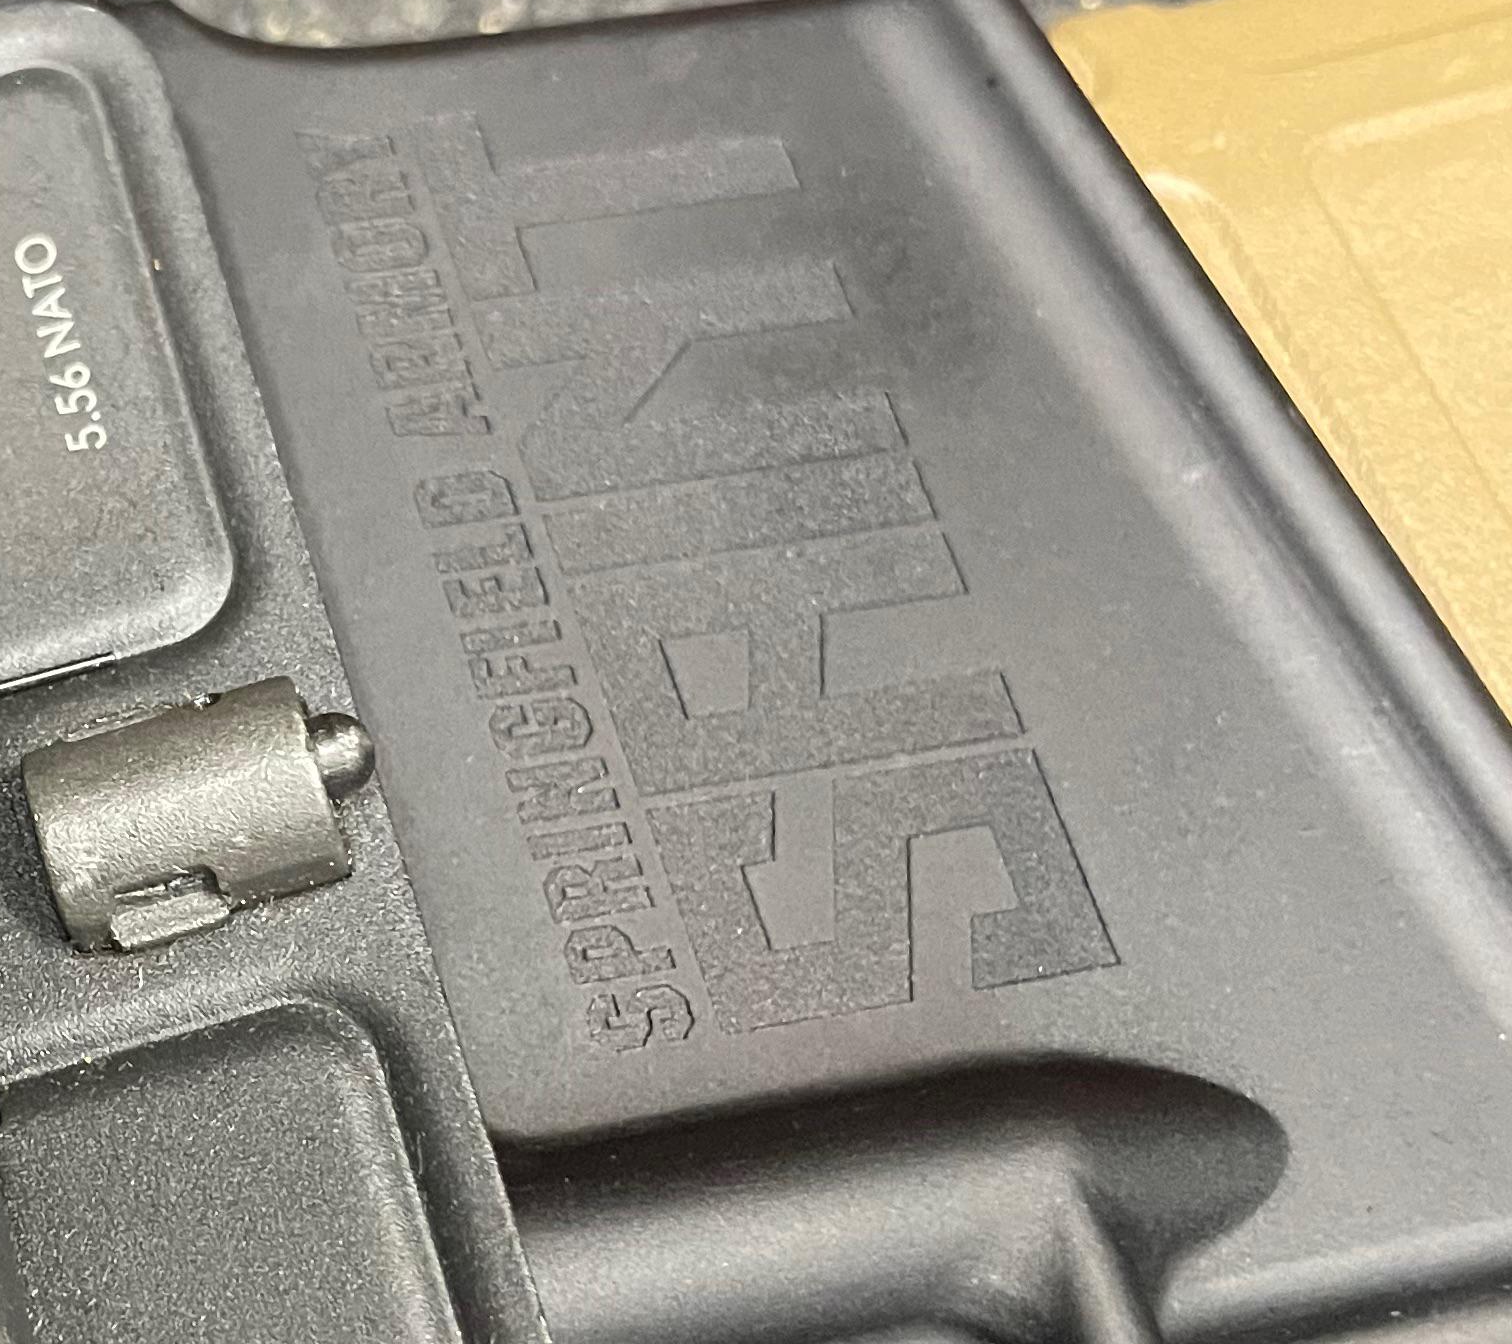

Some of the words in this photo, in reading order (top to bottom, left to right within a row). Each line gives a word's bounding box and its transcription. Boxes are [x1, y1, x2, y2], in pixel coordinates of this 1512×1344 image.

[14, 233, 81, 358] NATO
[49, 361, 107, 451] 5.56
[294, 130, 492, 437] ARMORY
[415, 109, 1122, 1034] SAINT
[413, 468, 695, 1052] SPRINGFIELD
